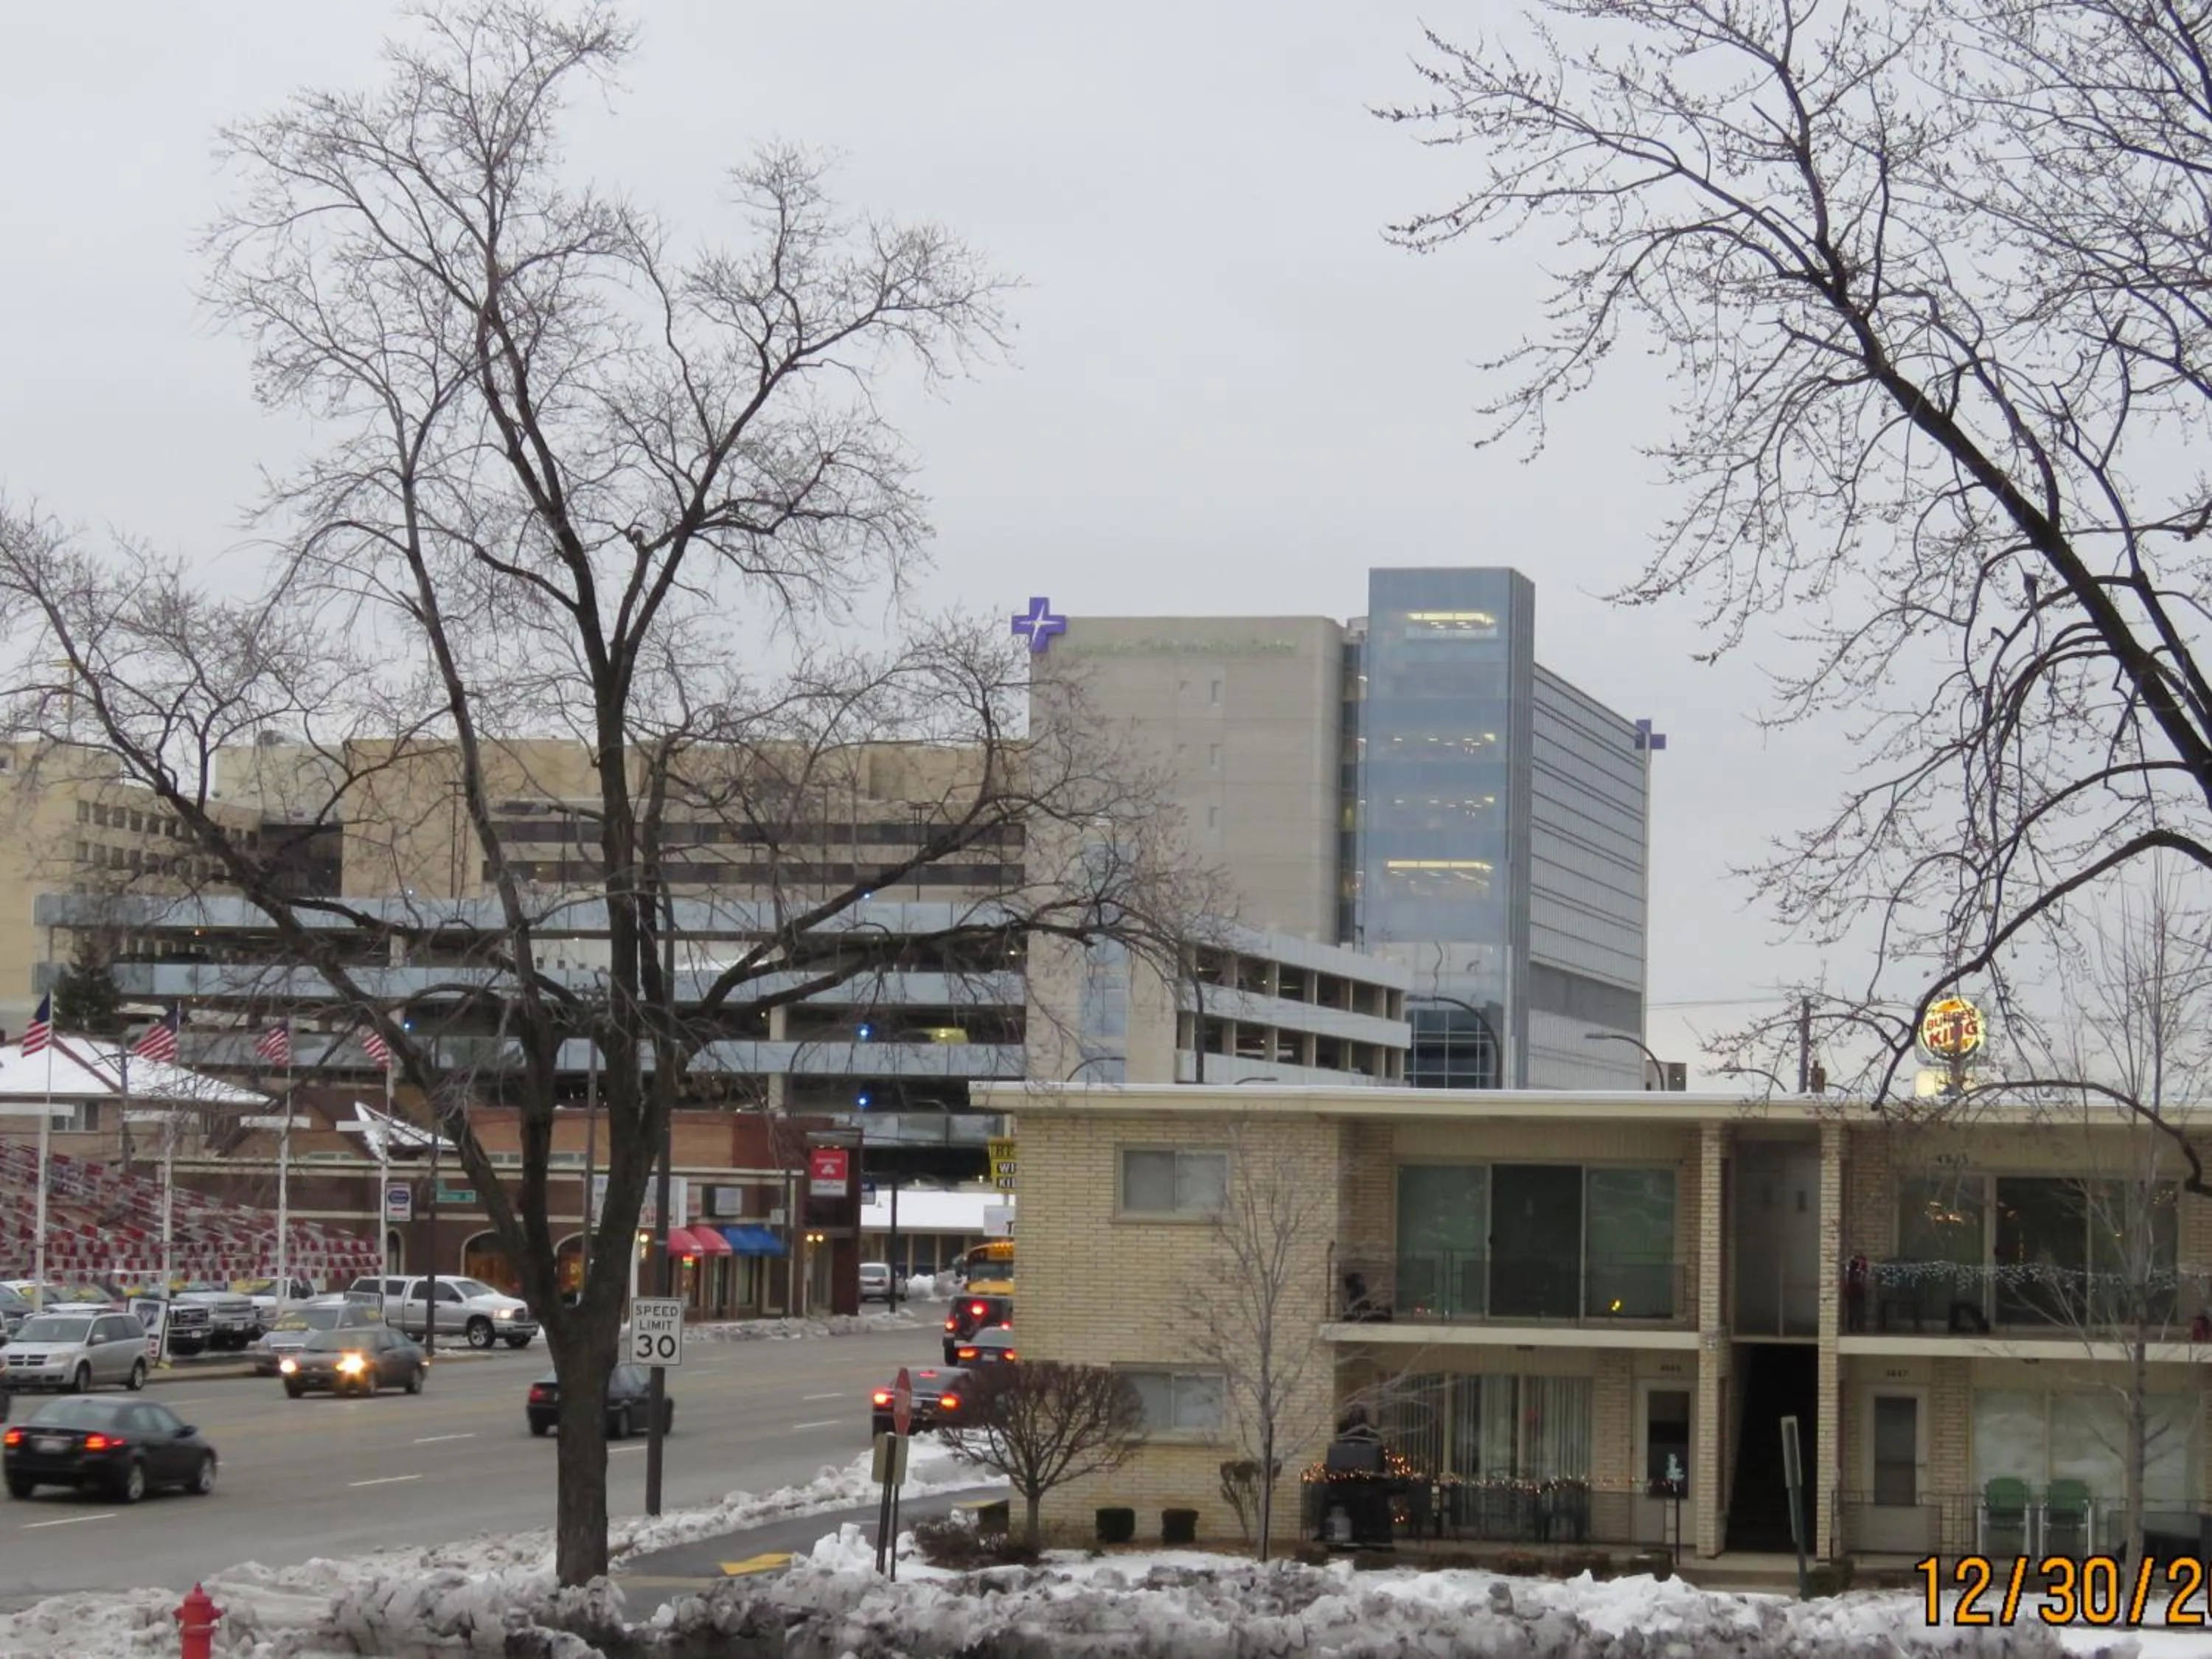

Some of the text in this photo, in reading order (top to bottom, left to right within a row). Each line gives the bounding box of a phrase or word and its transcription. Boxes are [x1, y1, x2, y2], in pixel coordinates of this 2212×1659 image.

[636, 1305, 679, 1317] SPEED
[639, 1319, 674, 1332] LIMIT
[636, 1334, 676, 1359] 30
